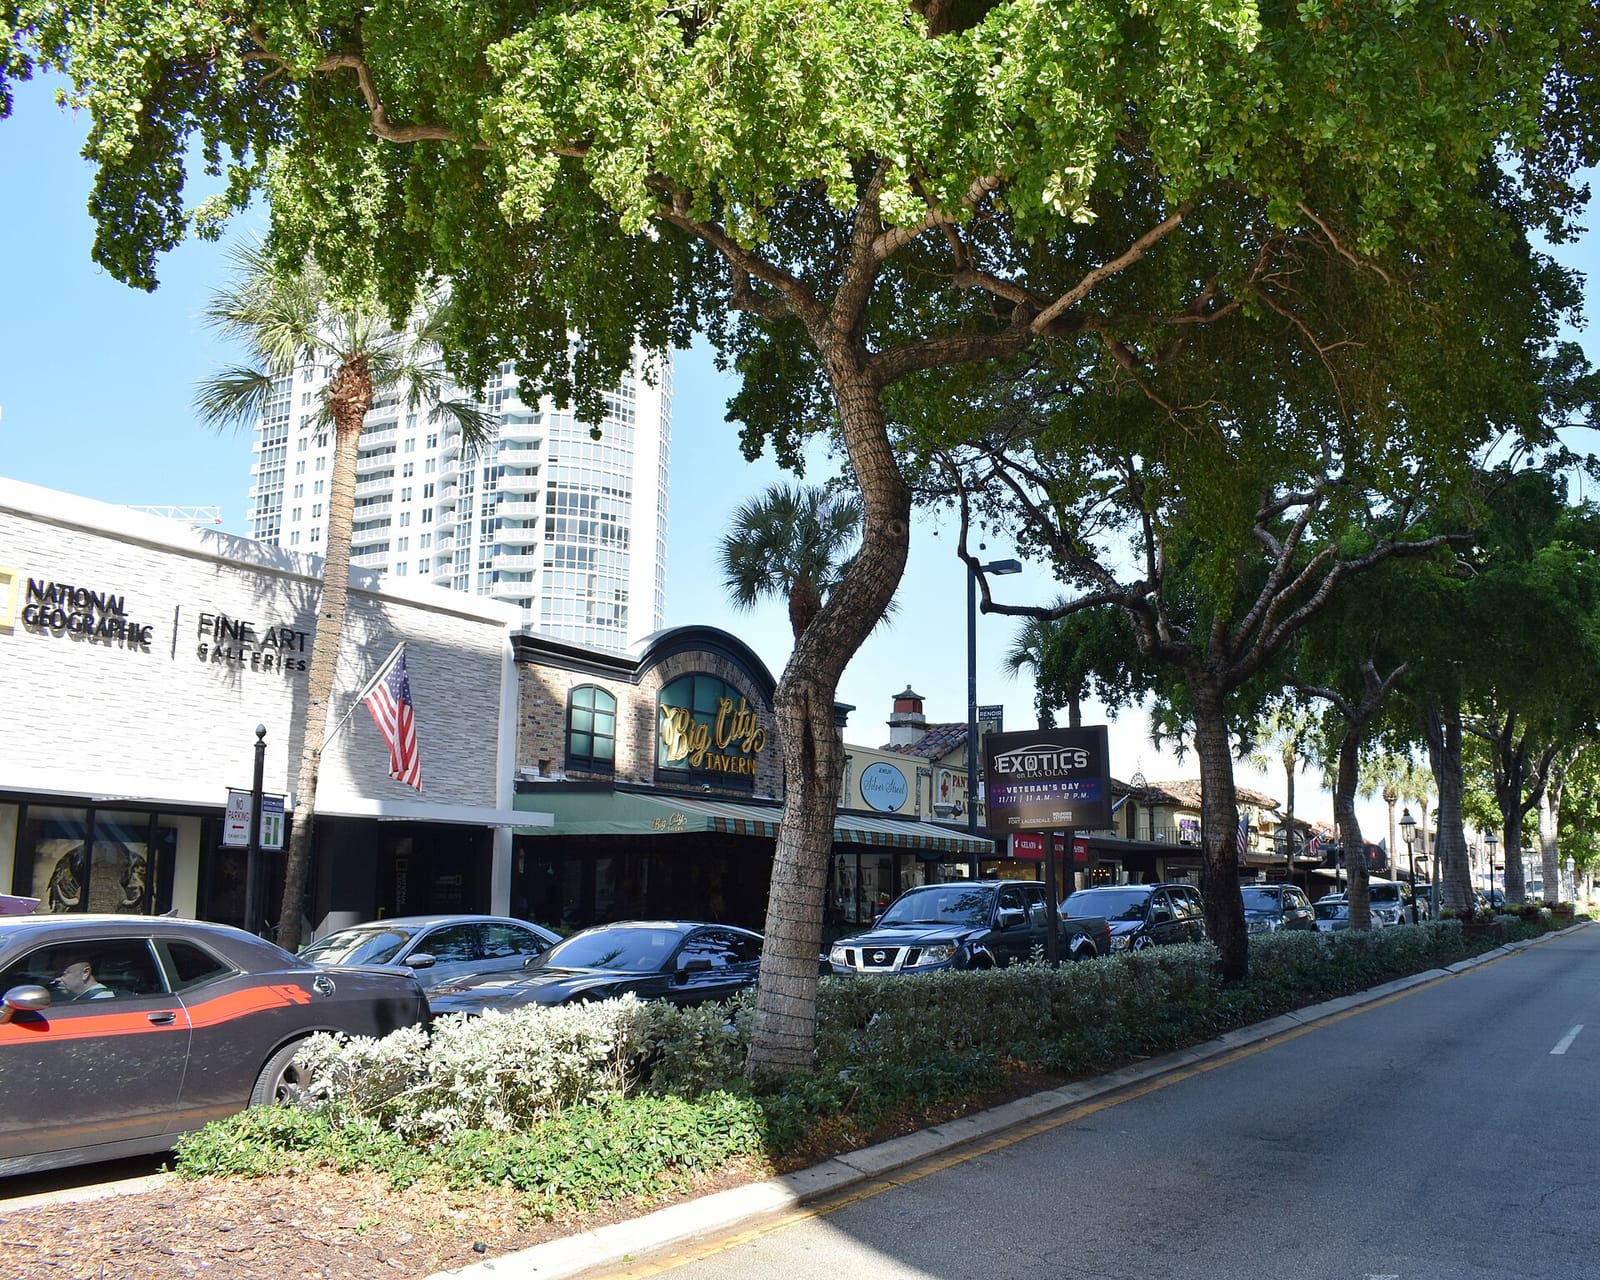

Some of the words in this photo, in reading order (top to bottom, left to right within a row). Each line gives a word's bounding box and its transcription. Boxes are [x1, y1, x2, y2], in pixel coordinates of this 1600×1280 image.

[26, 577, 129, 616] NATIONAL
[23, 604, 154, 645] GEOGRAPHIC
[199, 612, 255, 642] FINE
[261, 626, 310, 652] ART
[199, 643, 306, 671] GALLERIES
[660, 703, 712, 768] Big
[715, 697, 767, 753] City
[705, 752, 757, 776] TAVERN
[998, 752, 1088, 773] EXOTICS
[1027, 770, 1043, 778] LAS
[1045, 768, 1069, 777] OLAS
[998, 795, 1017, 803] 11/11
[1006, 784, 1058, 794] VETERAN'S
[1062, 783, 1080, 791] DAY
[236, 798, 244, 810] NO
[227, 810, 250, 822] PARKING
